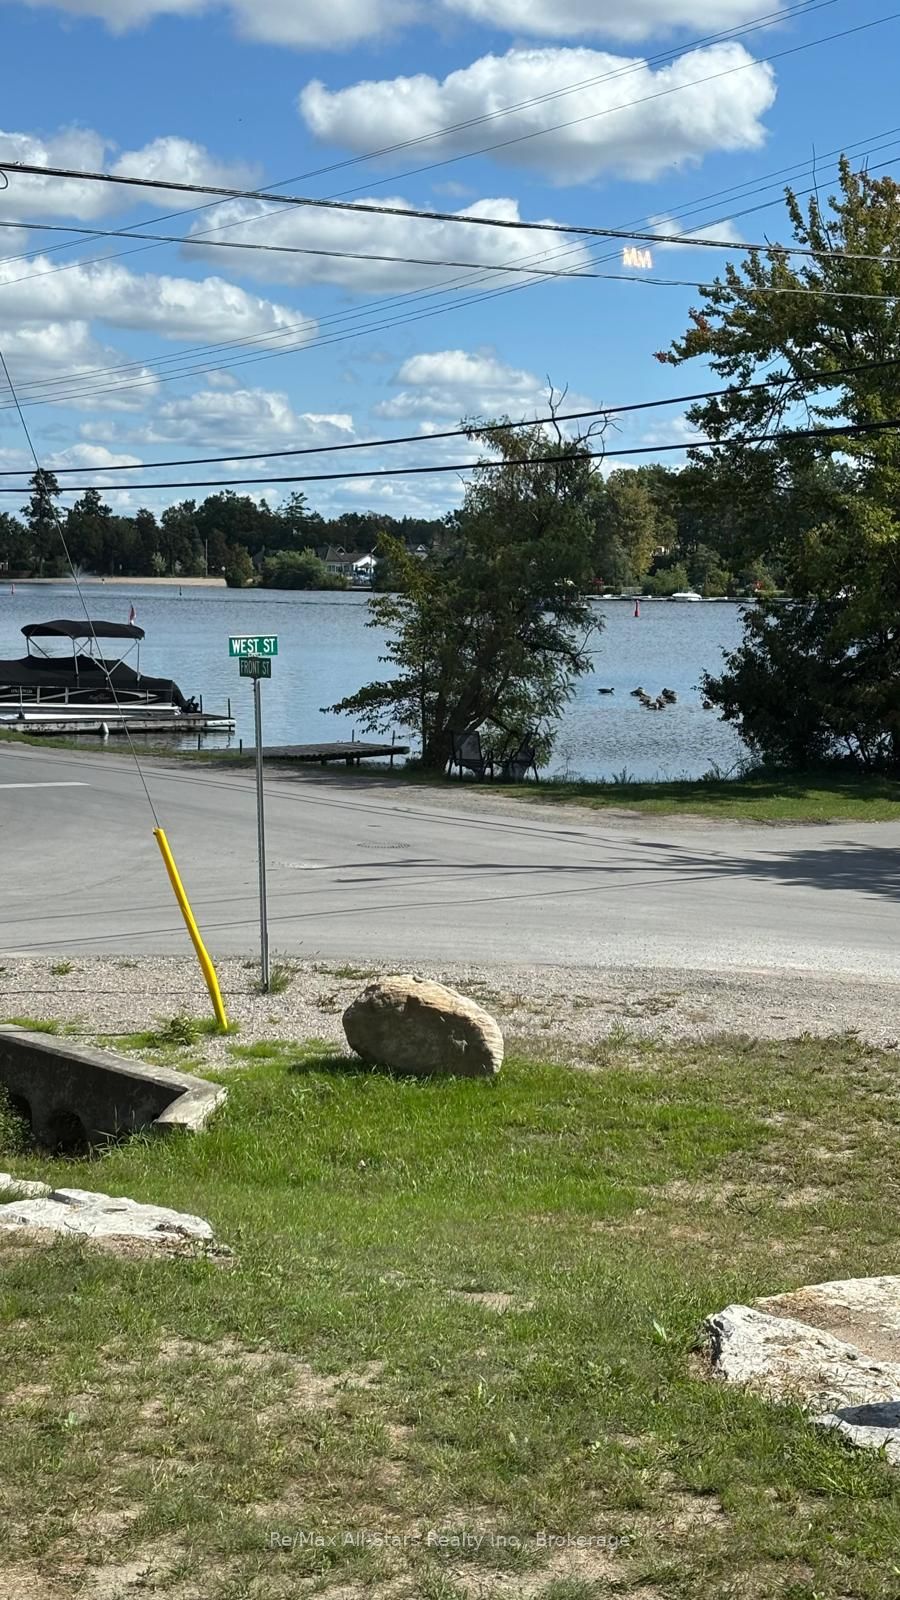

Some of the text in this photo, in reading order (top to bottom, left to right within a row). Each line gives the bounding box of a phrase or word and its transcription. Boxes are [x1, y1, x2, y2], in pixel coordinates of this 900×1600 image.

[232, 638, 276, 654] WEST ST
[241, 660, 270, 675] FRONT ST
